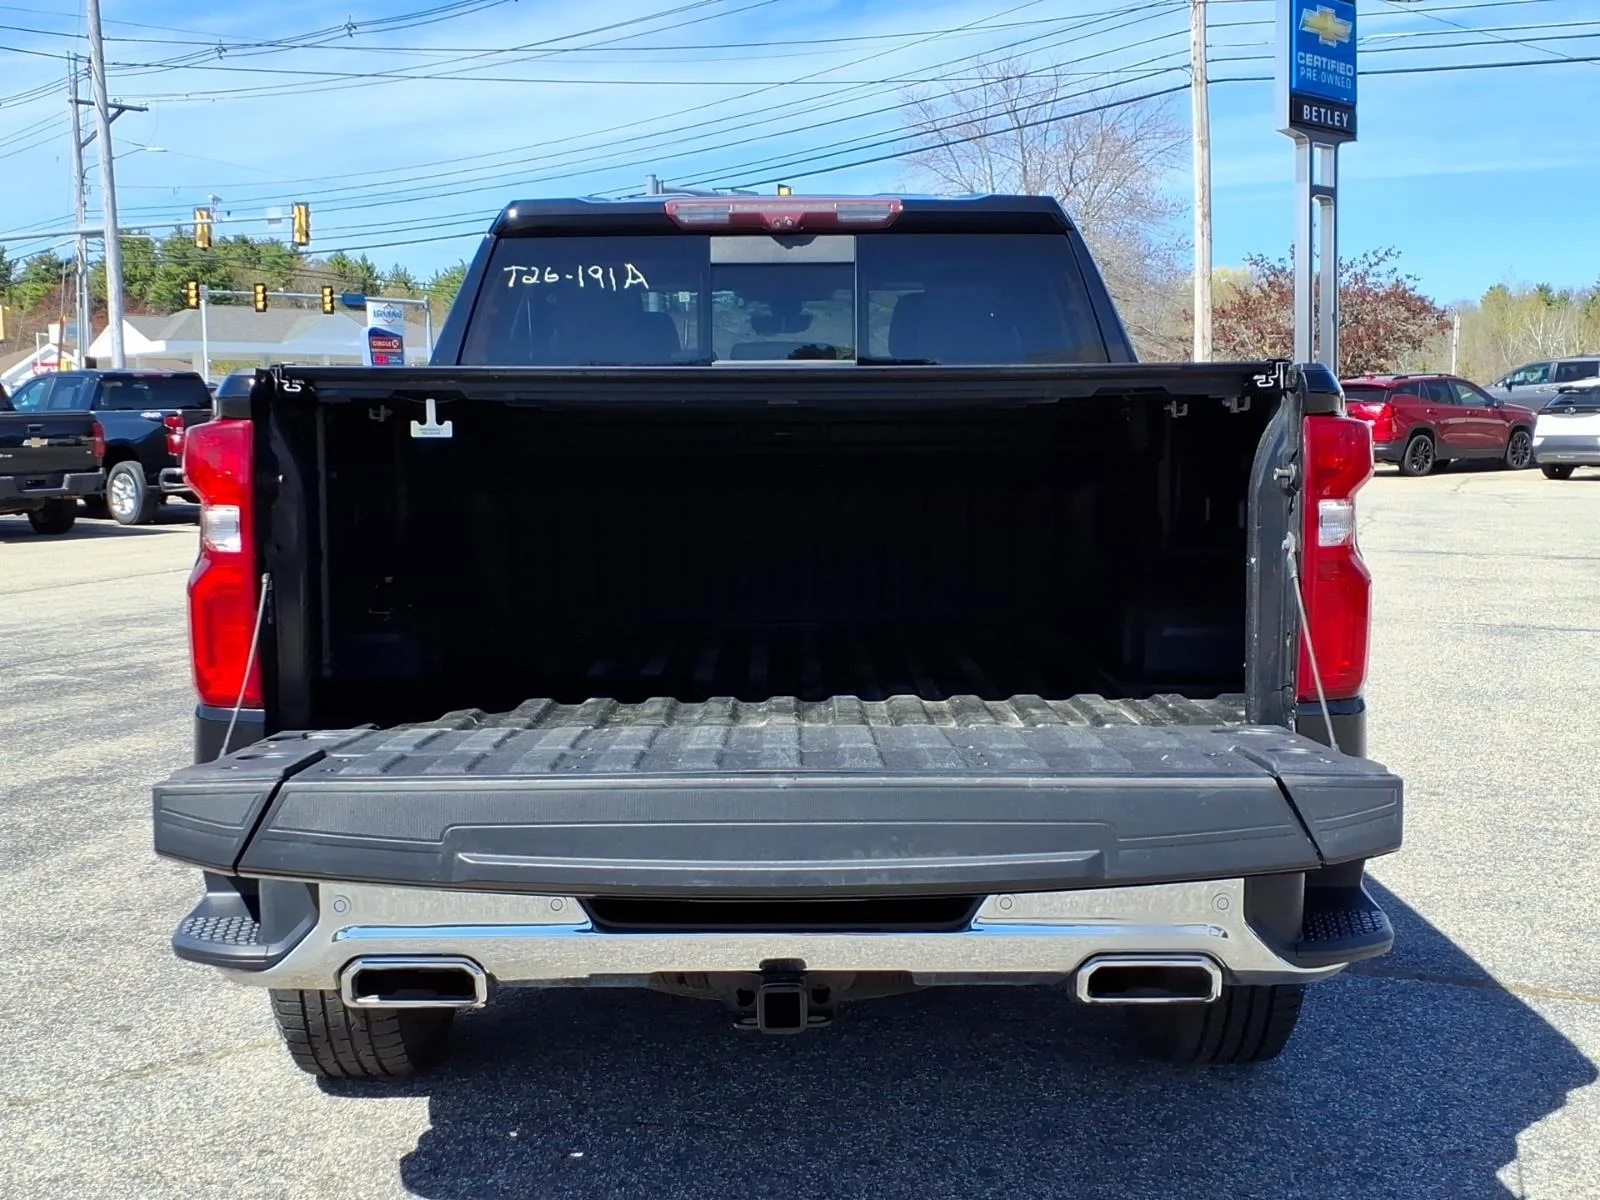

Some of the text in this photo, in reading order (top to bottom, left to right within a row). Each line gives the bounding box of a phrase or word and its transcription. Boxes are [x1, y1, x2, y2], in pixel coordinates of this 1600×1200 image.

[1297, 52, 1354, 77] CERTIFIED
[1300, 67, 1352, 89] PRE-OWNED
[1303, 104, 1348, 127] BETLEY
[503, 263, 649, 292] T26-191A
